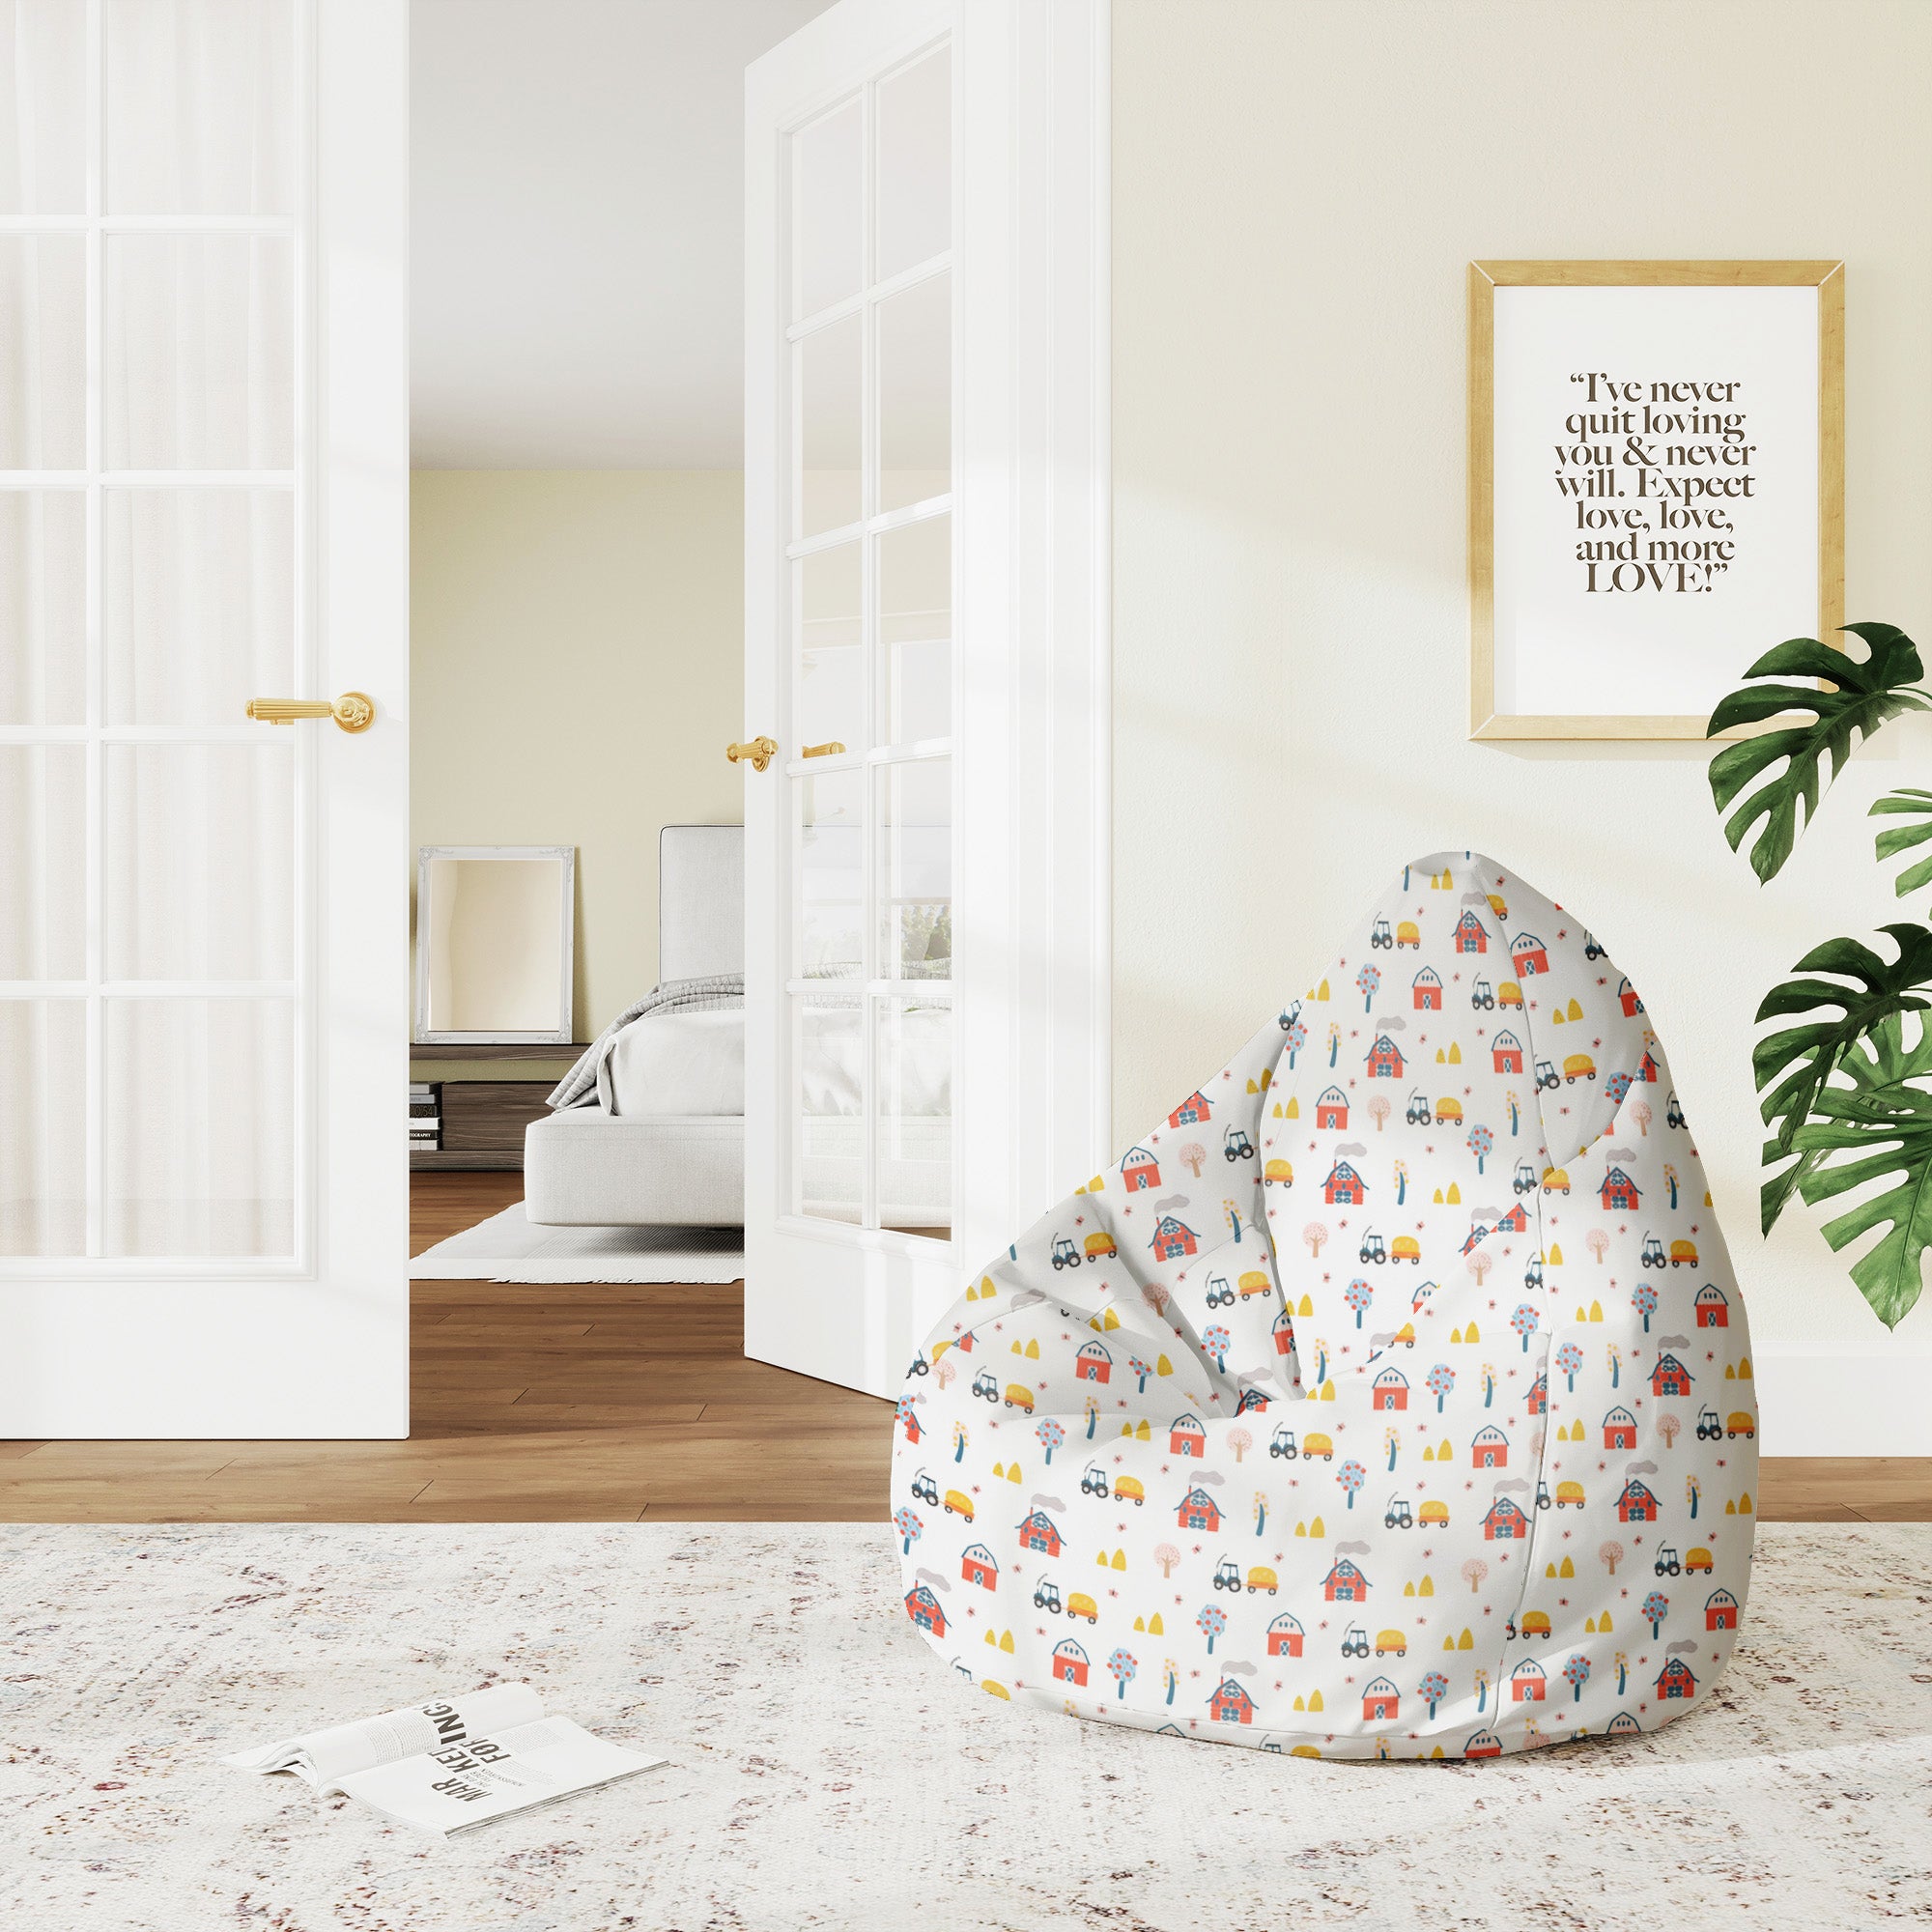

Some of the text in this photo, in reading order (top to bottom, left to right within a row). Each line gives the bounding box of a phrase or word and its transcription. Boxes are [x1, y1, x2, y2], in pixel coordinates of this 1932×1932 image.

[1649, 381, 1742, 403] never
[1565, 404, 1747, 444] quit loving
[1553, 436, 1757, 475] you & never
[1553, 468, 1756, 507] will. Expect
[1575, 499, 1734, 534] love, love,
[1575, 531, 1736, 561] and more
[431, 1777, 494, 1803] MAR
